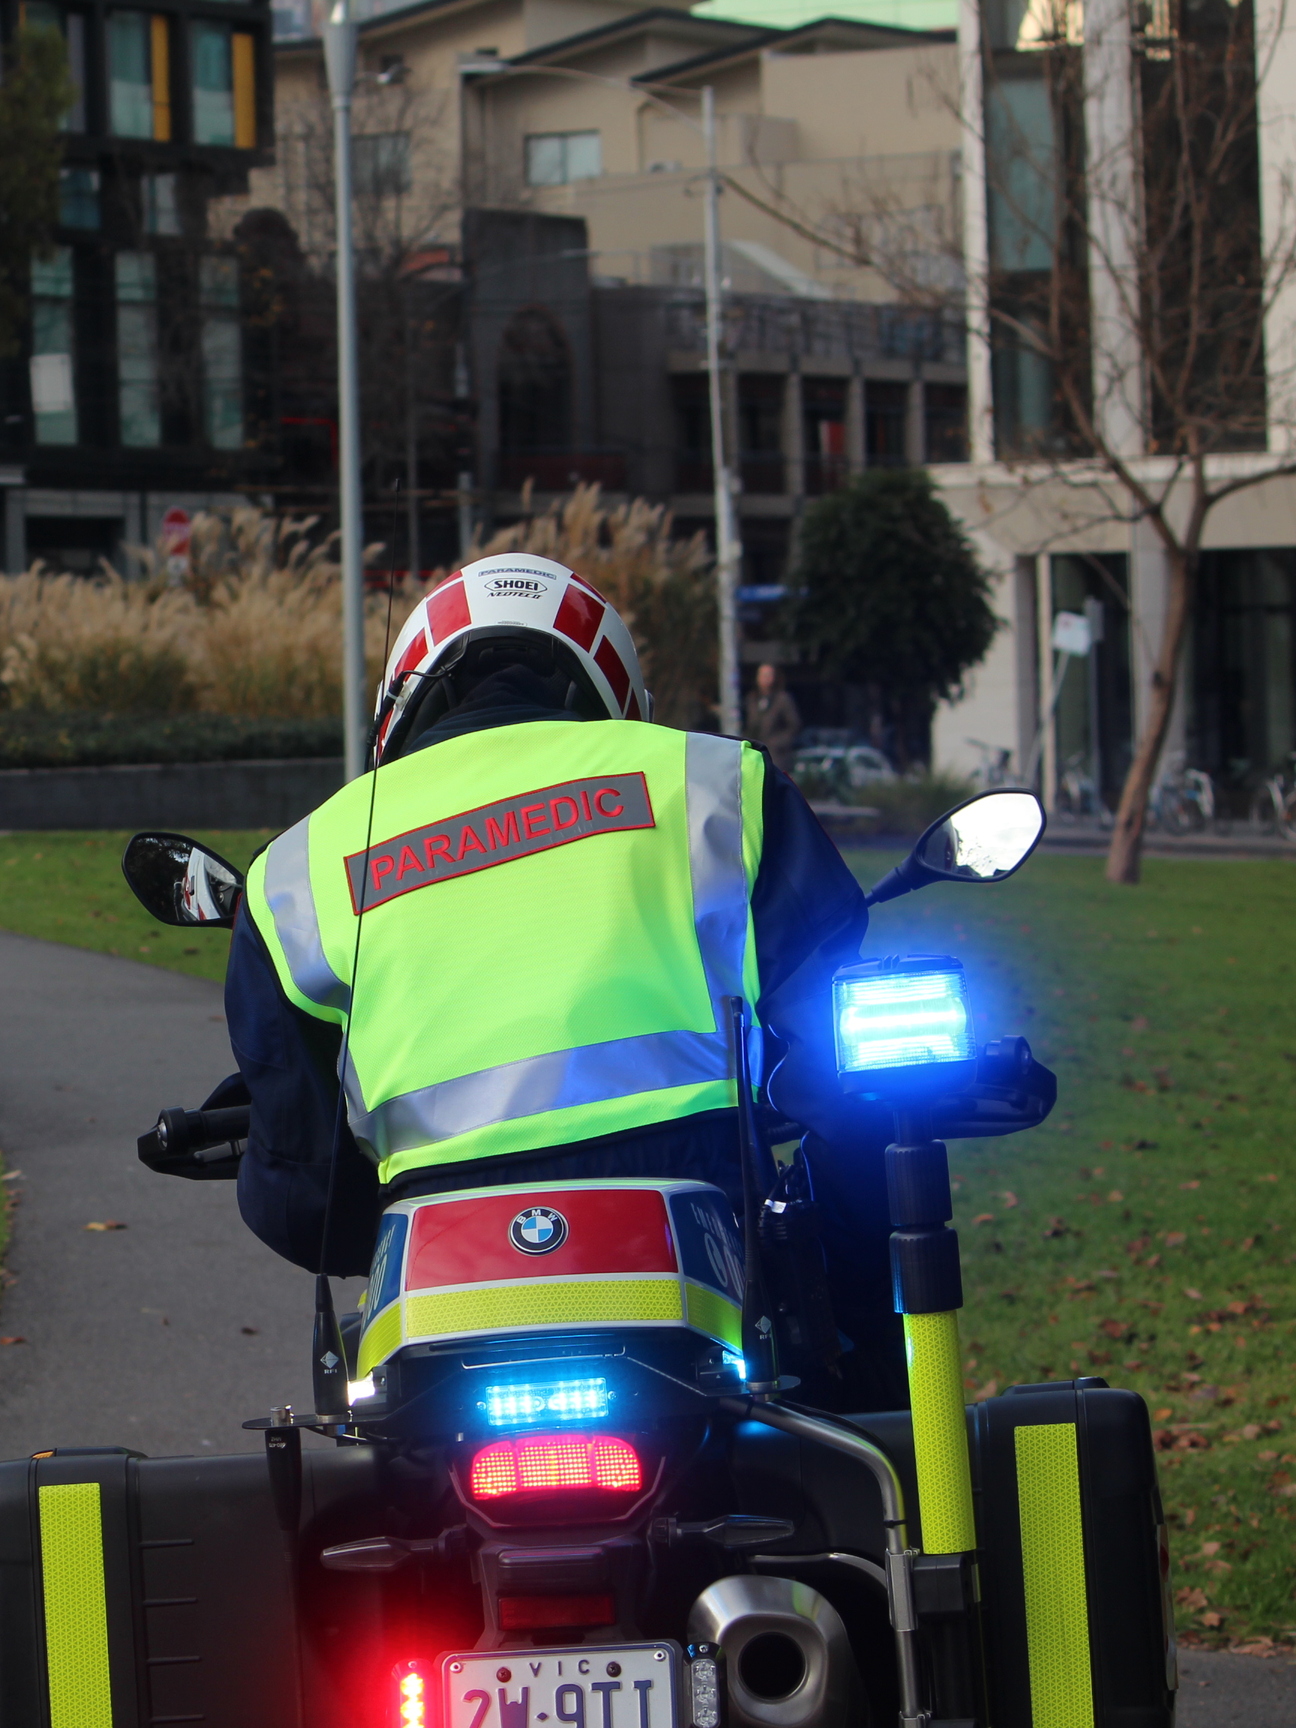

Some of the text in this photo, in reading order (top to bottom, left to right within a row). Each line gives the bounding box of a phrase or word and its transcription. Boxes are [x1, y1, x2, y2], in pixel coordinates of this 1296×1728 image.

[480, 568, 555, 580] PARAMEDIC
[493, 580, 539, 591] SHOEI
[369, 787, 625, 891] PARAMEDIC
[529, 1659, 591, 1678] VIC
